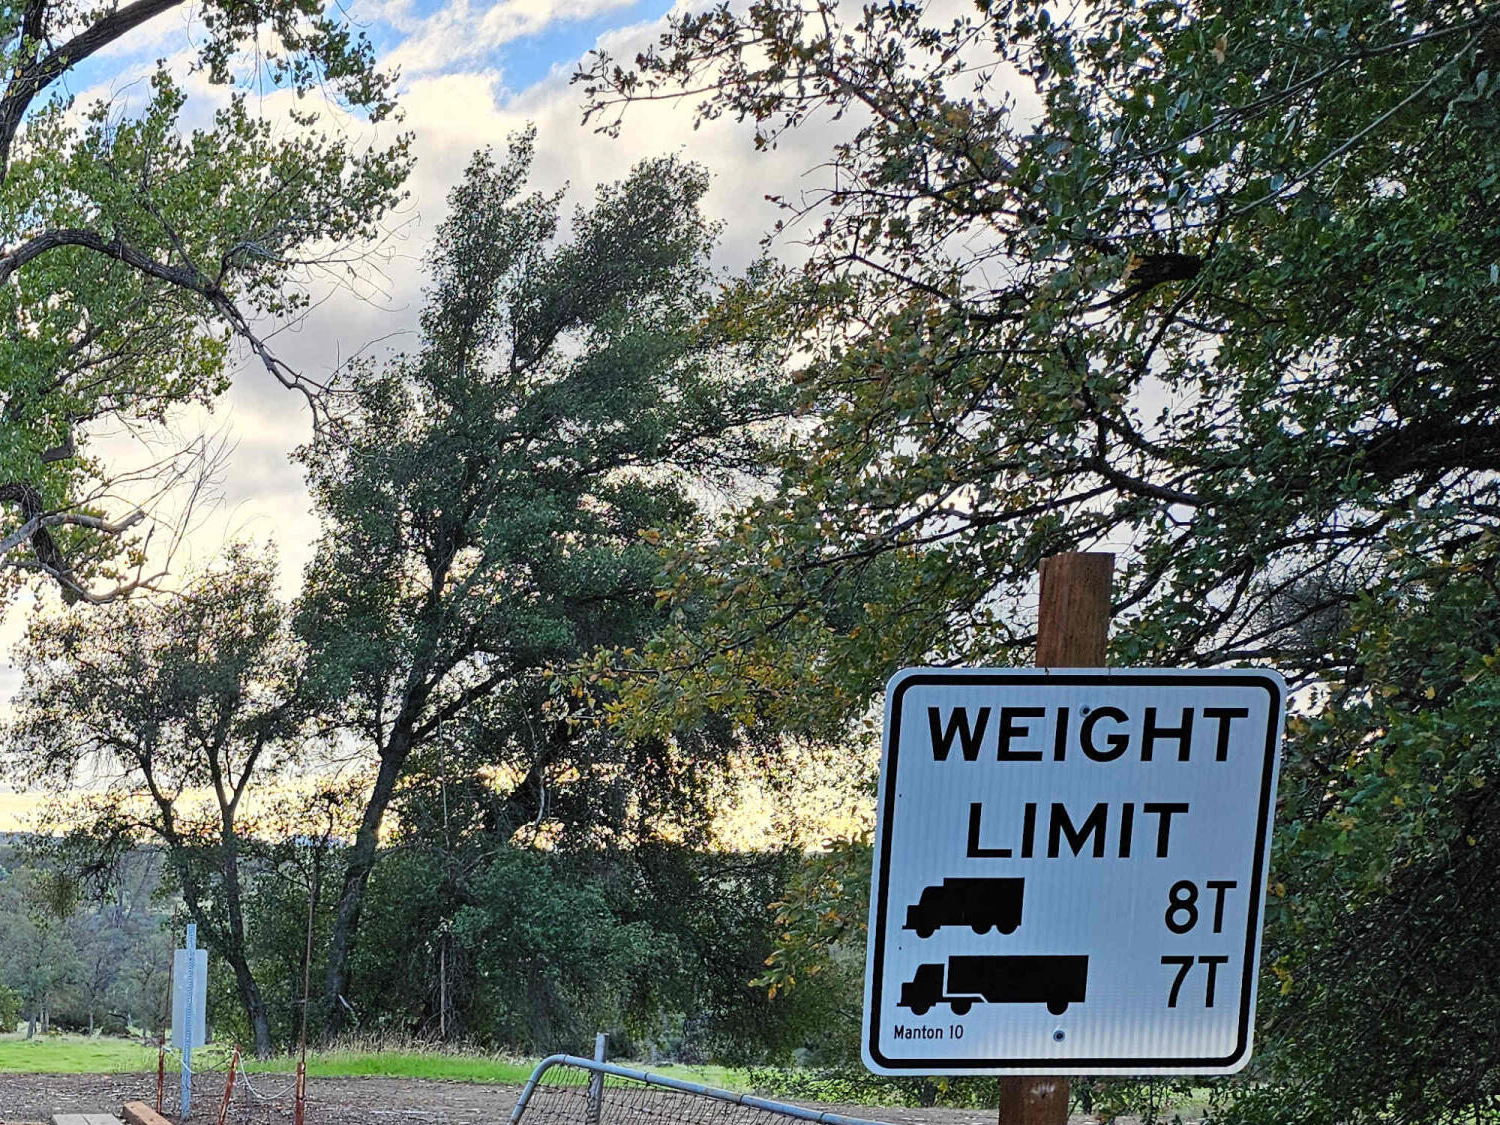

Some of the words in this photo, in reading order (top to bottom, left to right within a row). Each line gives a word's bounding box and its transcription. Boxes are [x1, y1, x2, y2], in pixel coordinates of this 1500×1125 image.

[928, 706, 1249, 762] WEIGHT
[966, 803, 1189, 859] LIMIT
[1165, 880, 1238, 935] 8T
[1160, 956, 1229, 1008] 7T
[894, 1024, 944, 1040] Manton
[949, 1024, 964, 1040] 10
